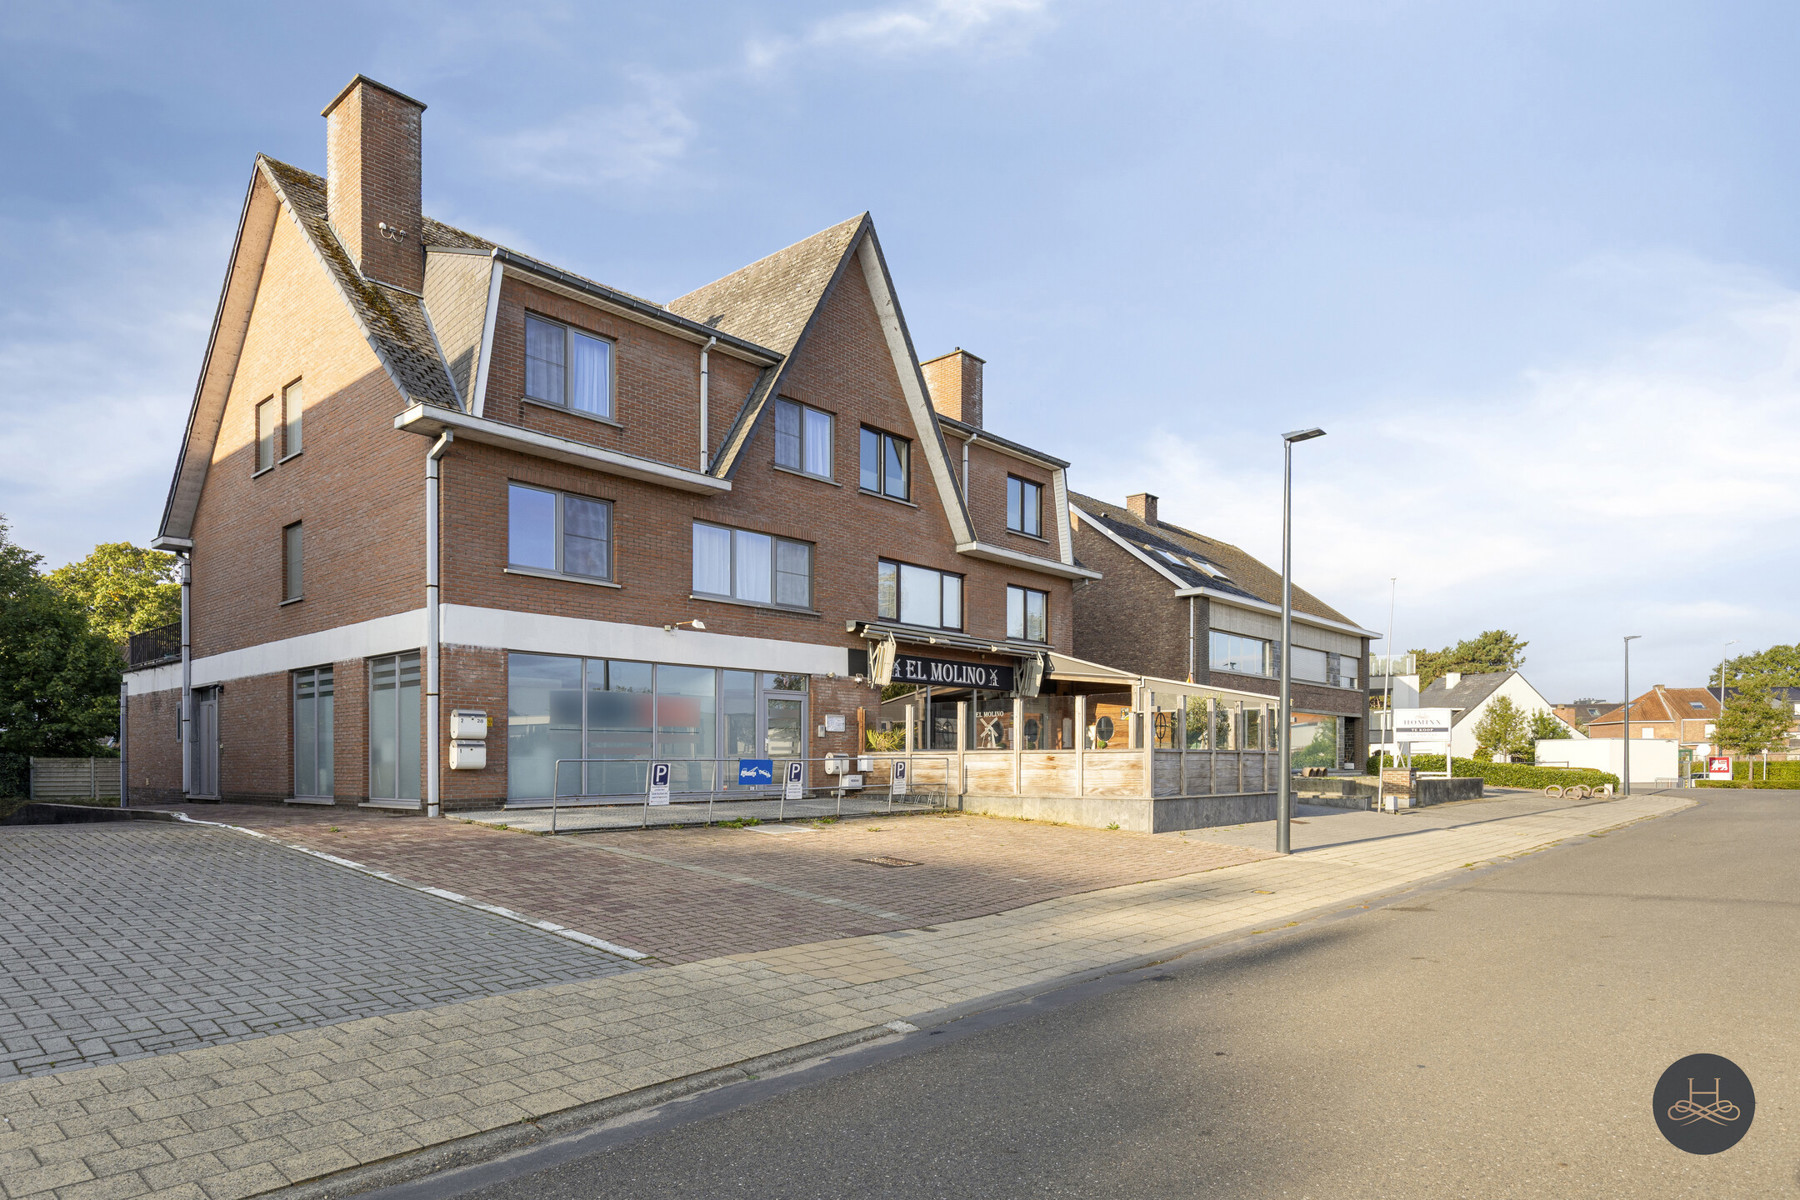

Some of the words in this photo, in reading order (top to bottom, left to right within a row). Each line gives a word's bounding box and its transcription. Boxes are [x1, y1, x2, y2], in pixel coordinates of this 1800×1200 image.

[906, 659, 927, 680] EL
[930, 662, 986, 685] MOLINO
[655, 765, 667, 782] P
[791, 763, 800, 779] P
[896, 762, 904, 776] P
